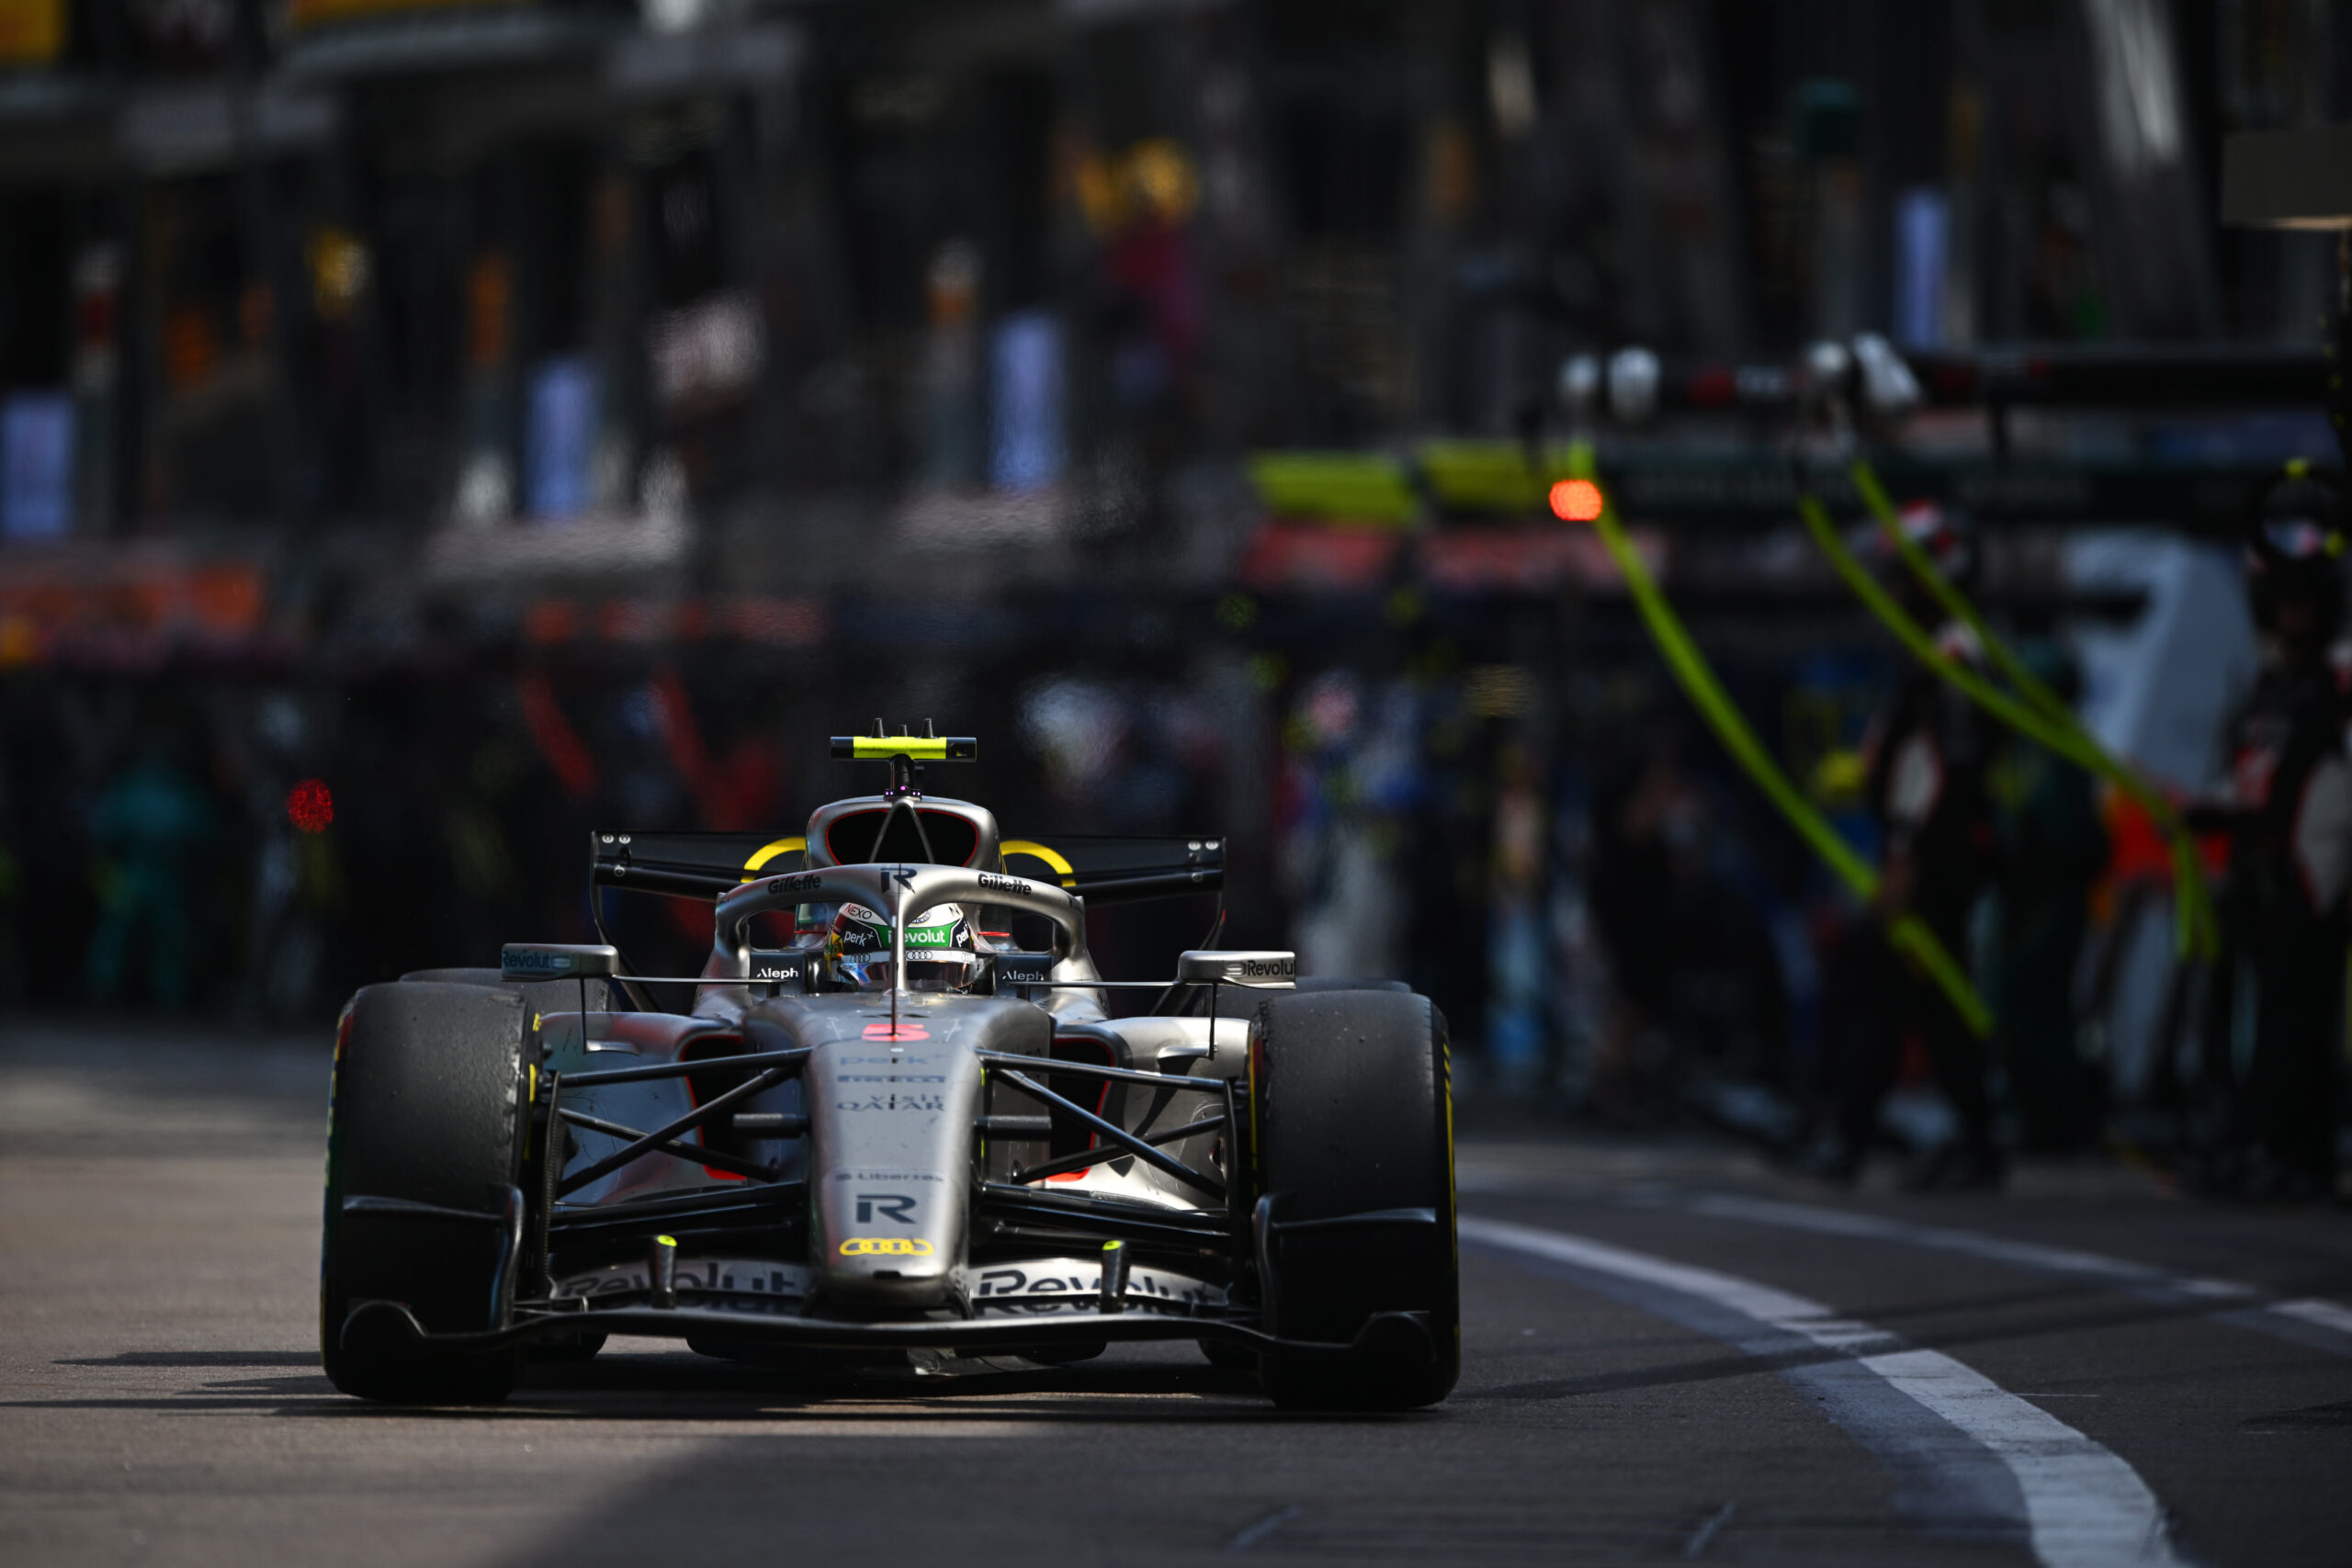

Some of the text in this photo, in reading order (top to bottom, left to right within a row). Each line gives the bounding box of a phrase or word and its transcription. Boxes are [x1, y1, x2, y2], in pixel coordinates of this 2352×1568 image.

[768, 874, 822, 895] Gillette
[978, 874, 1032, 896] Gillette
[845, 904, 872, 919] NEXO
[503, 951, 550, 968] Revolut
[757, 967, 798, 979] Aleph
[1002, 970, 1044, 982] Aleph
